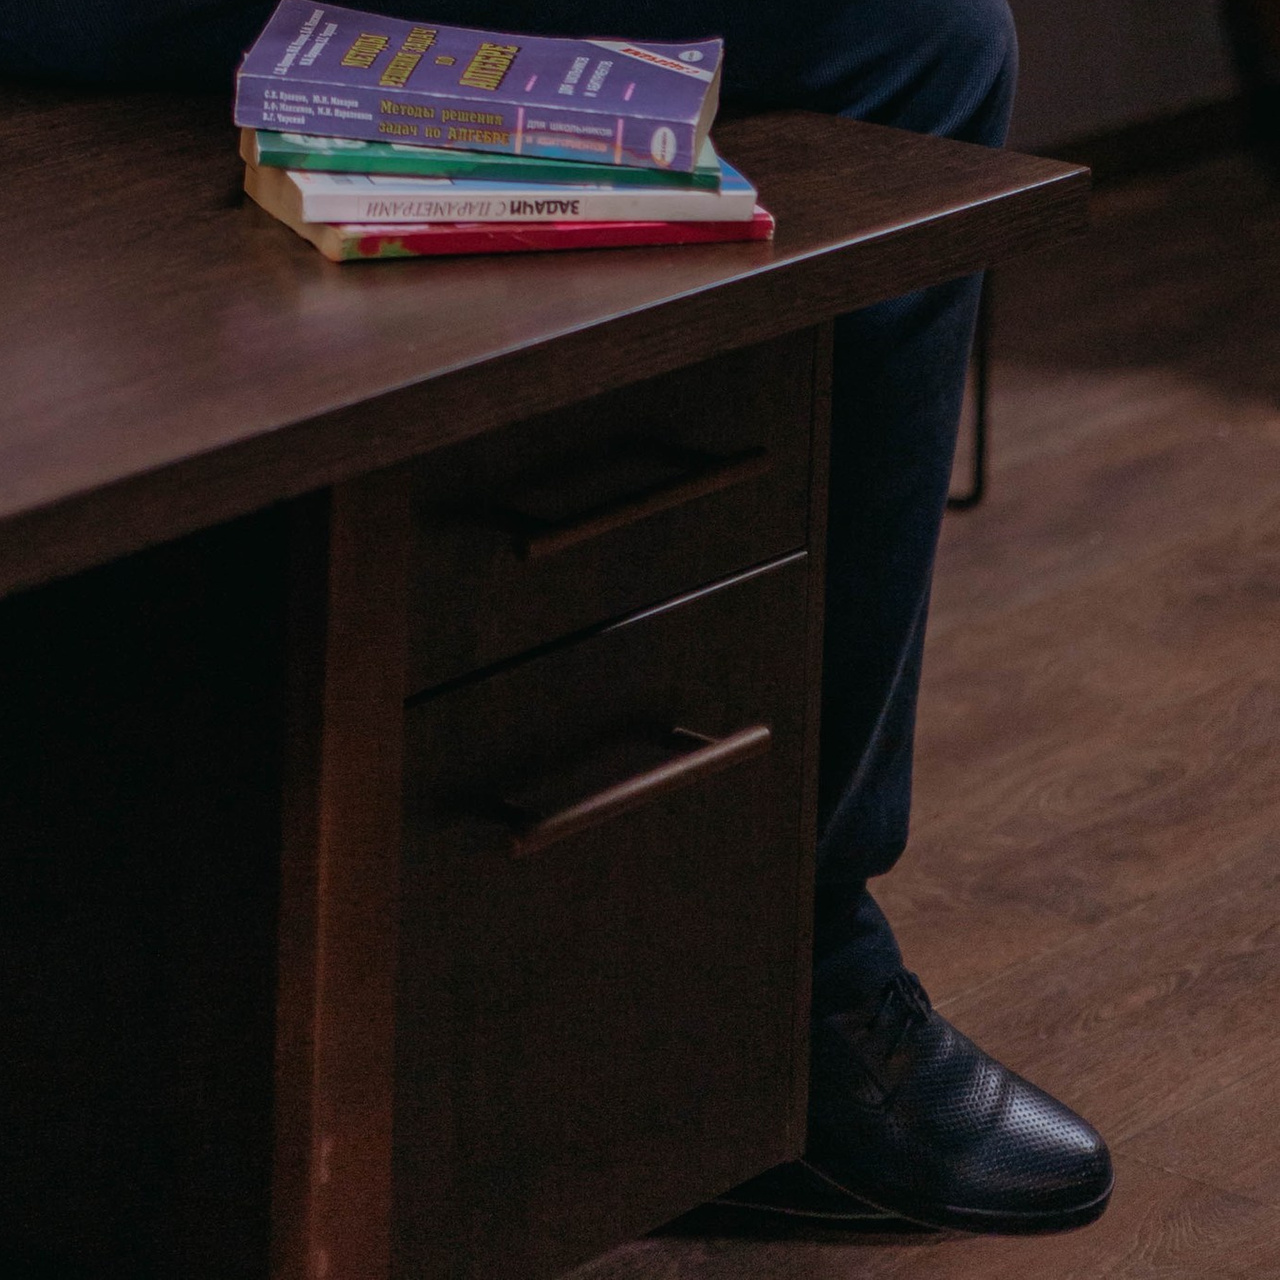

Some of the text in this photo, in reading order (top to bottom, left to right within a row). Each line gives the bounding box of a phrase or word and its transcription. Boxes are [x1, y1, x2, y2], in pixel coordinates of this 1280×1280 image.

[339, 32, 391, 69] МЕТОДЫ
[458, 42, 521, 90] АЛГЕБРЕ
[379, 98, 503, 127] Методы решения
[378, 121, 419, 138] задач
[424, 124, 442, 139] по
[365, 200, 493, 218] ПАРАМЕТРАМИ
[509, 198, 581, 216] ЗАДАЧИ
